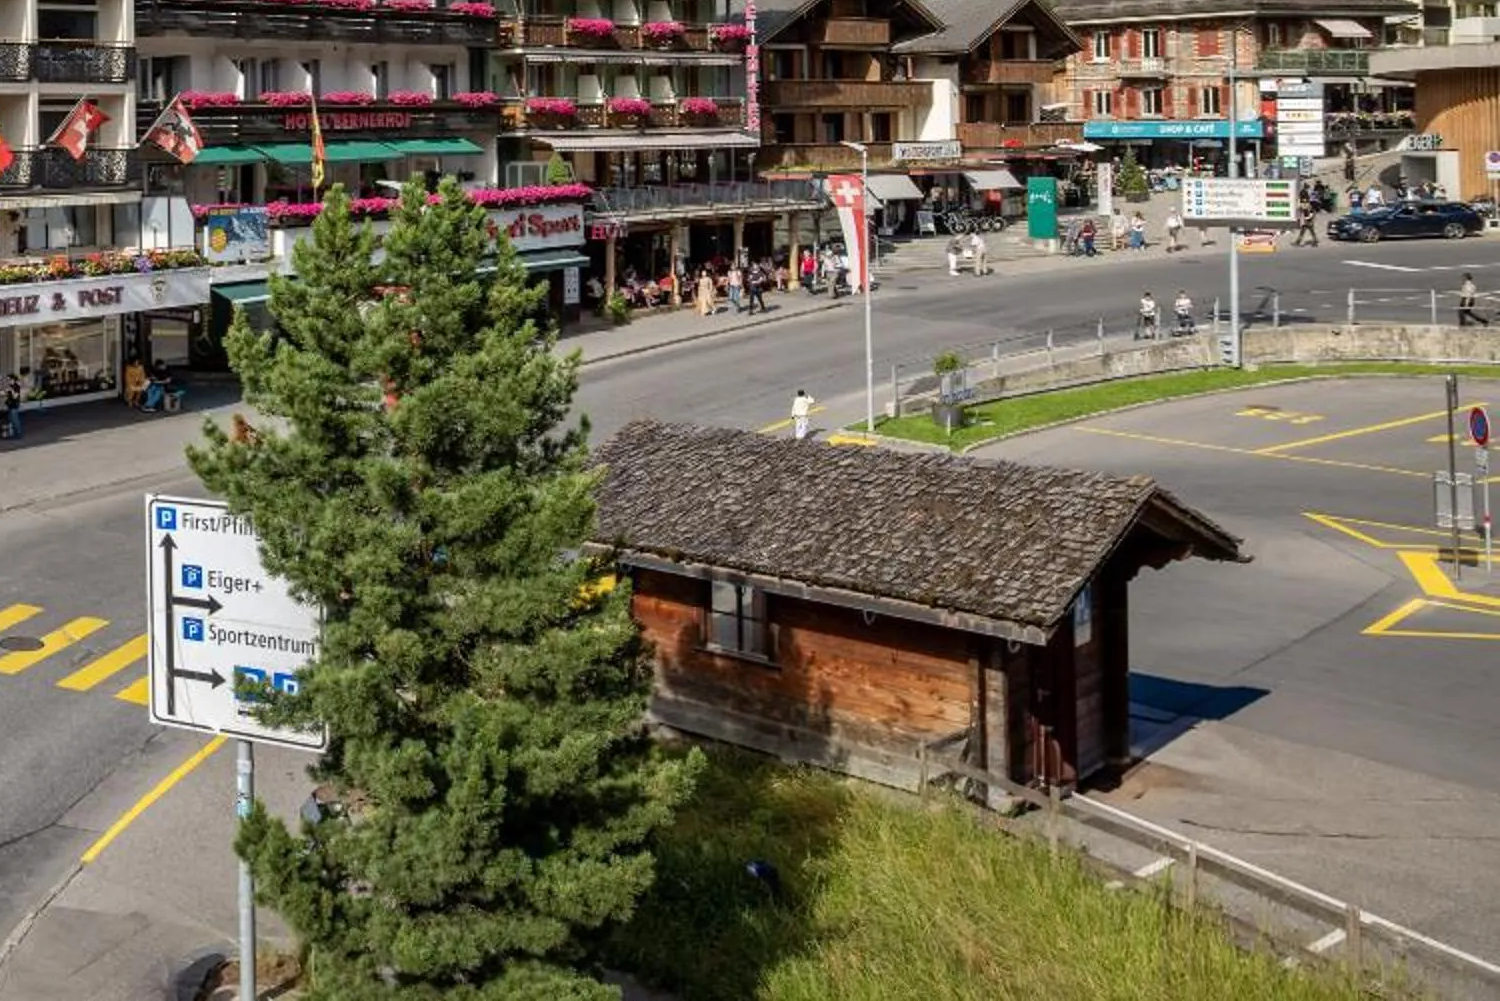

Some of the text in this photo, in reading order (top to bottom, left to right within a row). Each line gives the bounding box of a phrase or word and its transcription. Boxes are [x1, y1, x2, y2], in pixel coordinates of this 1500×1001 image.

[51, 292, 66, 311] &
[78, 286, 125, 307] POST
[208, 570, 263, 594] Eiger+
[208, 624, 315, 656] Sportzentrum
